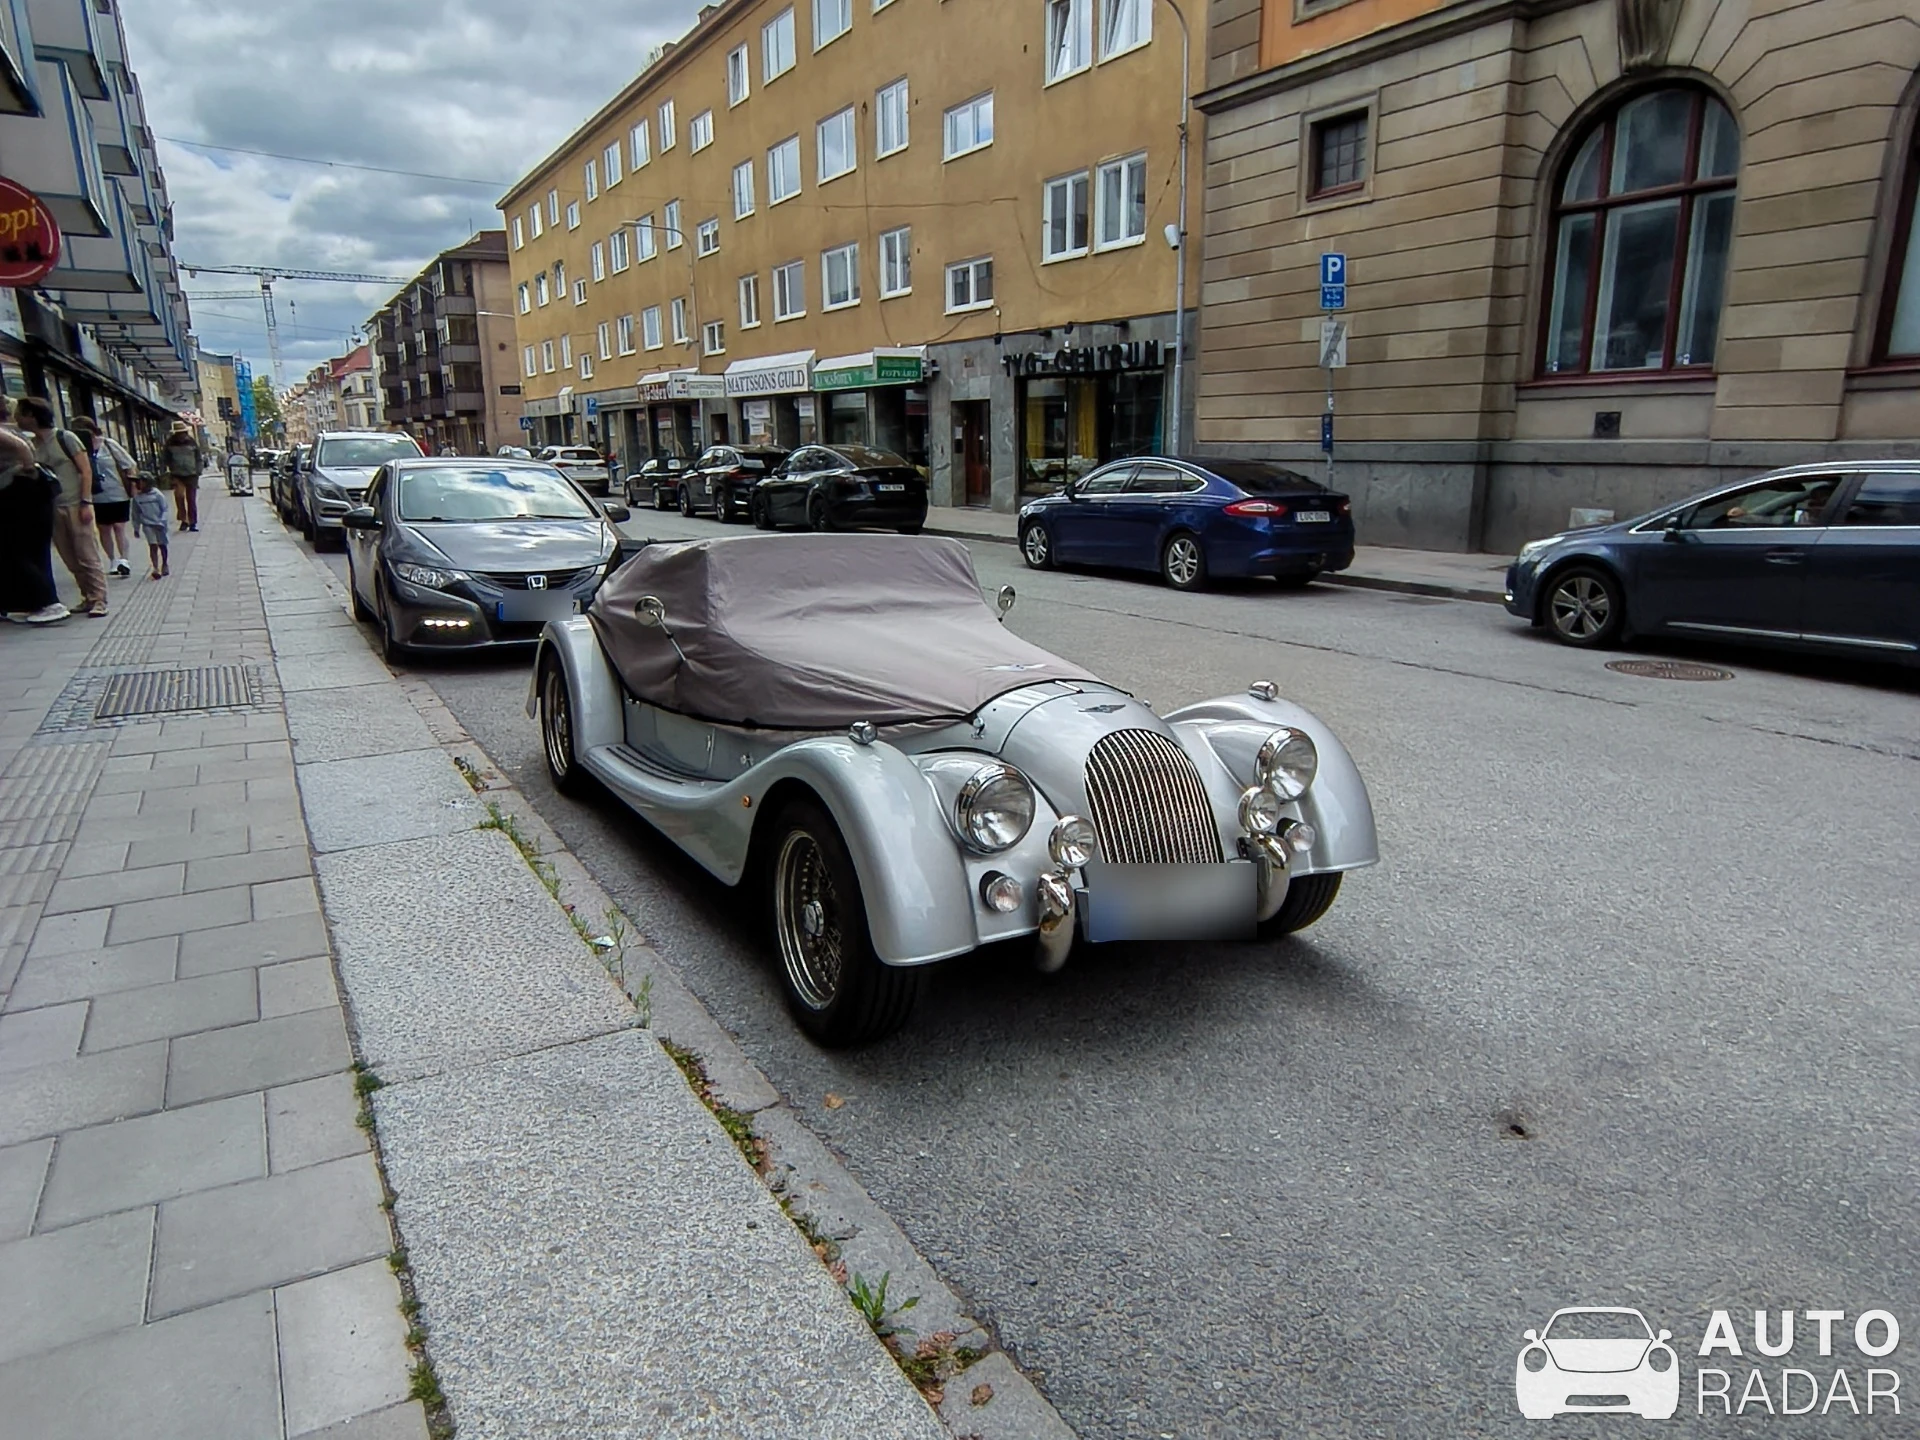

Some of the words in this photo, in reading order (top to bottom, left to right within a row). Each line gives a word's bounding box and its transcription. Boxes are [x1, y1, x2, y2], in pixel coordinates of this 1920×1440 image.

[1327, 257, 1342, 282] P
[727, 371, 777, 393] MATTSSONS
[777, 369, 805, 388] GULD
[881, 368, 918, 378] FOTVÅRD
